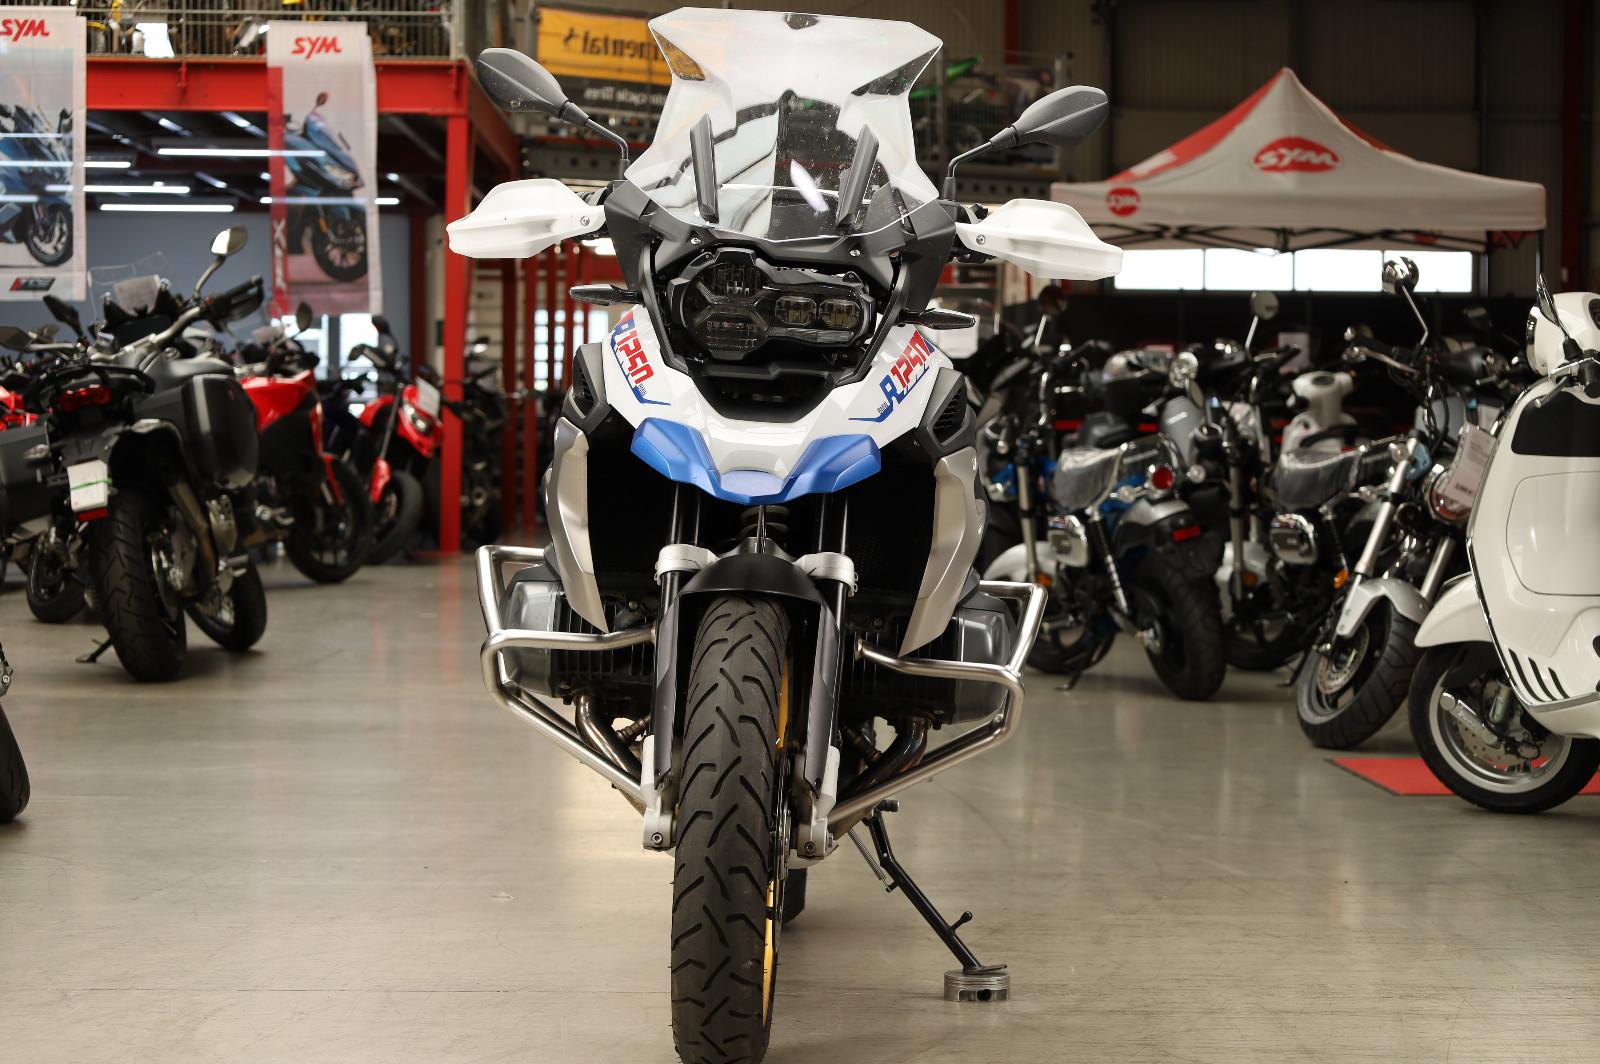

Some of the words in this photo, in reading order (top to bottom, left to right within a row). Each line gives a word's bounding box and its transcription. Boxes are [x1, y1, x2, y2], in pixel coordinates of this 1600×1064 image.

[0, 18, 50, 42] SYM
[291, 35, 343, 60] SYM
[1260, 147, 1340, 168] SYM
